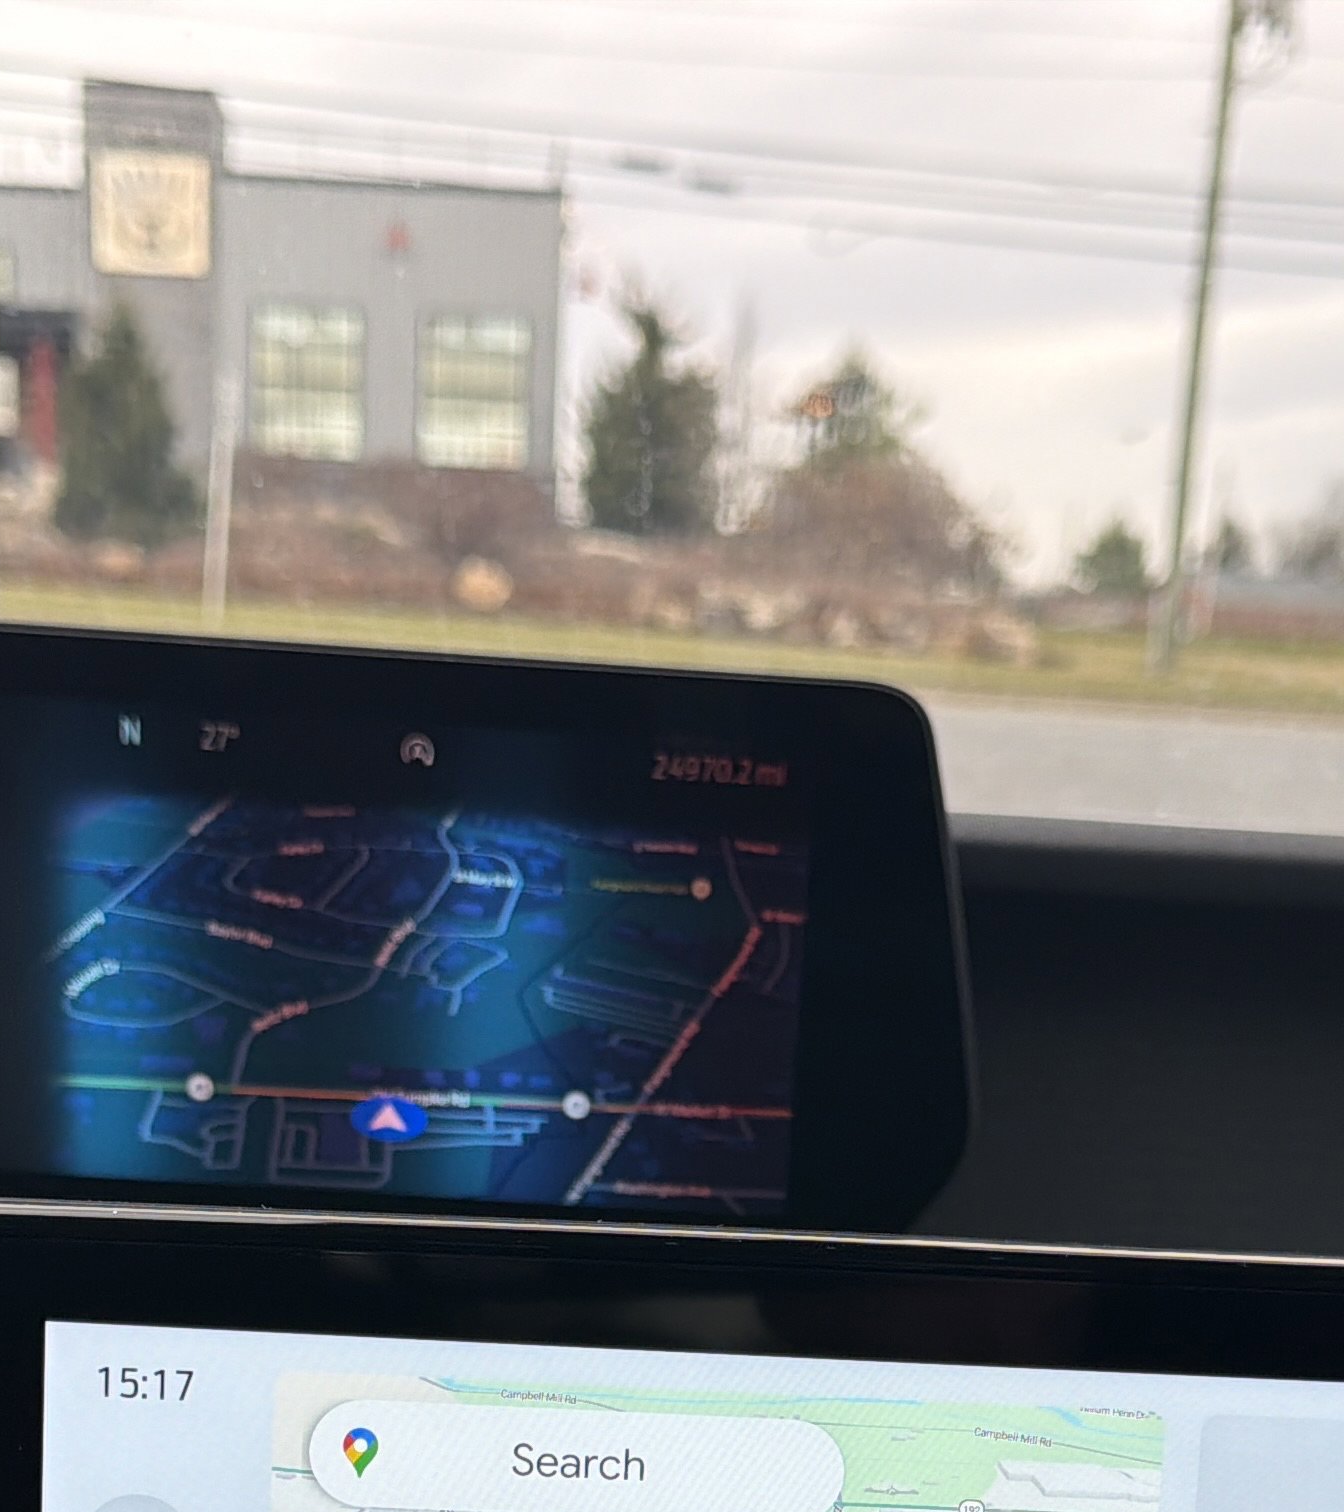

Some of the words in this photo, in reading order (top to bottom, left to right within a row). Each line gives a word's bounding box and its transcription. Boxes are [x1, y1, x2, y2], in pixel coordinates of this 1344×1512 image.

[97, 1366, 194, 1401] 15:17
[501, 1389, 544, 1400] Campbell
[974, 1427, 1019, 1442] Campbell
[1039, 1438, 1052, 1448] Rd
[512, 1443, 645, 1481] Search
